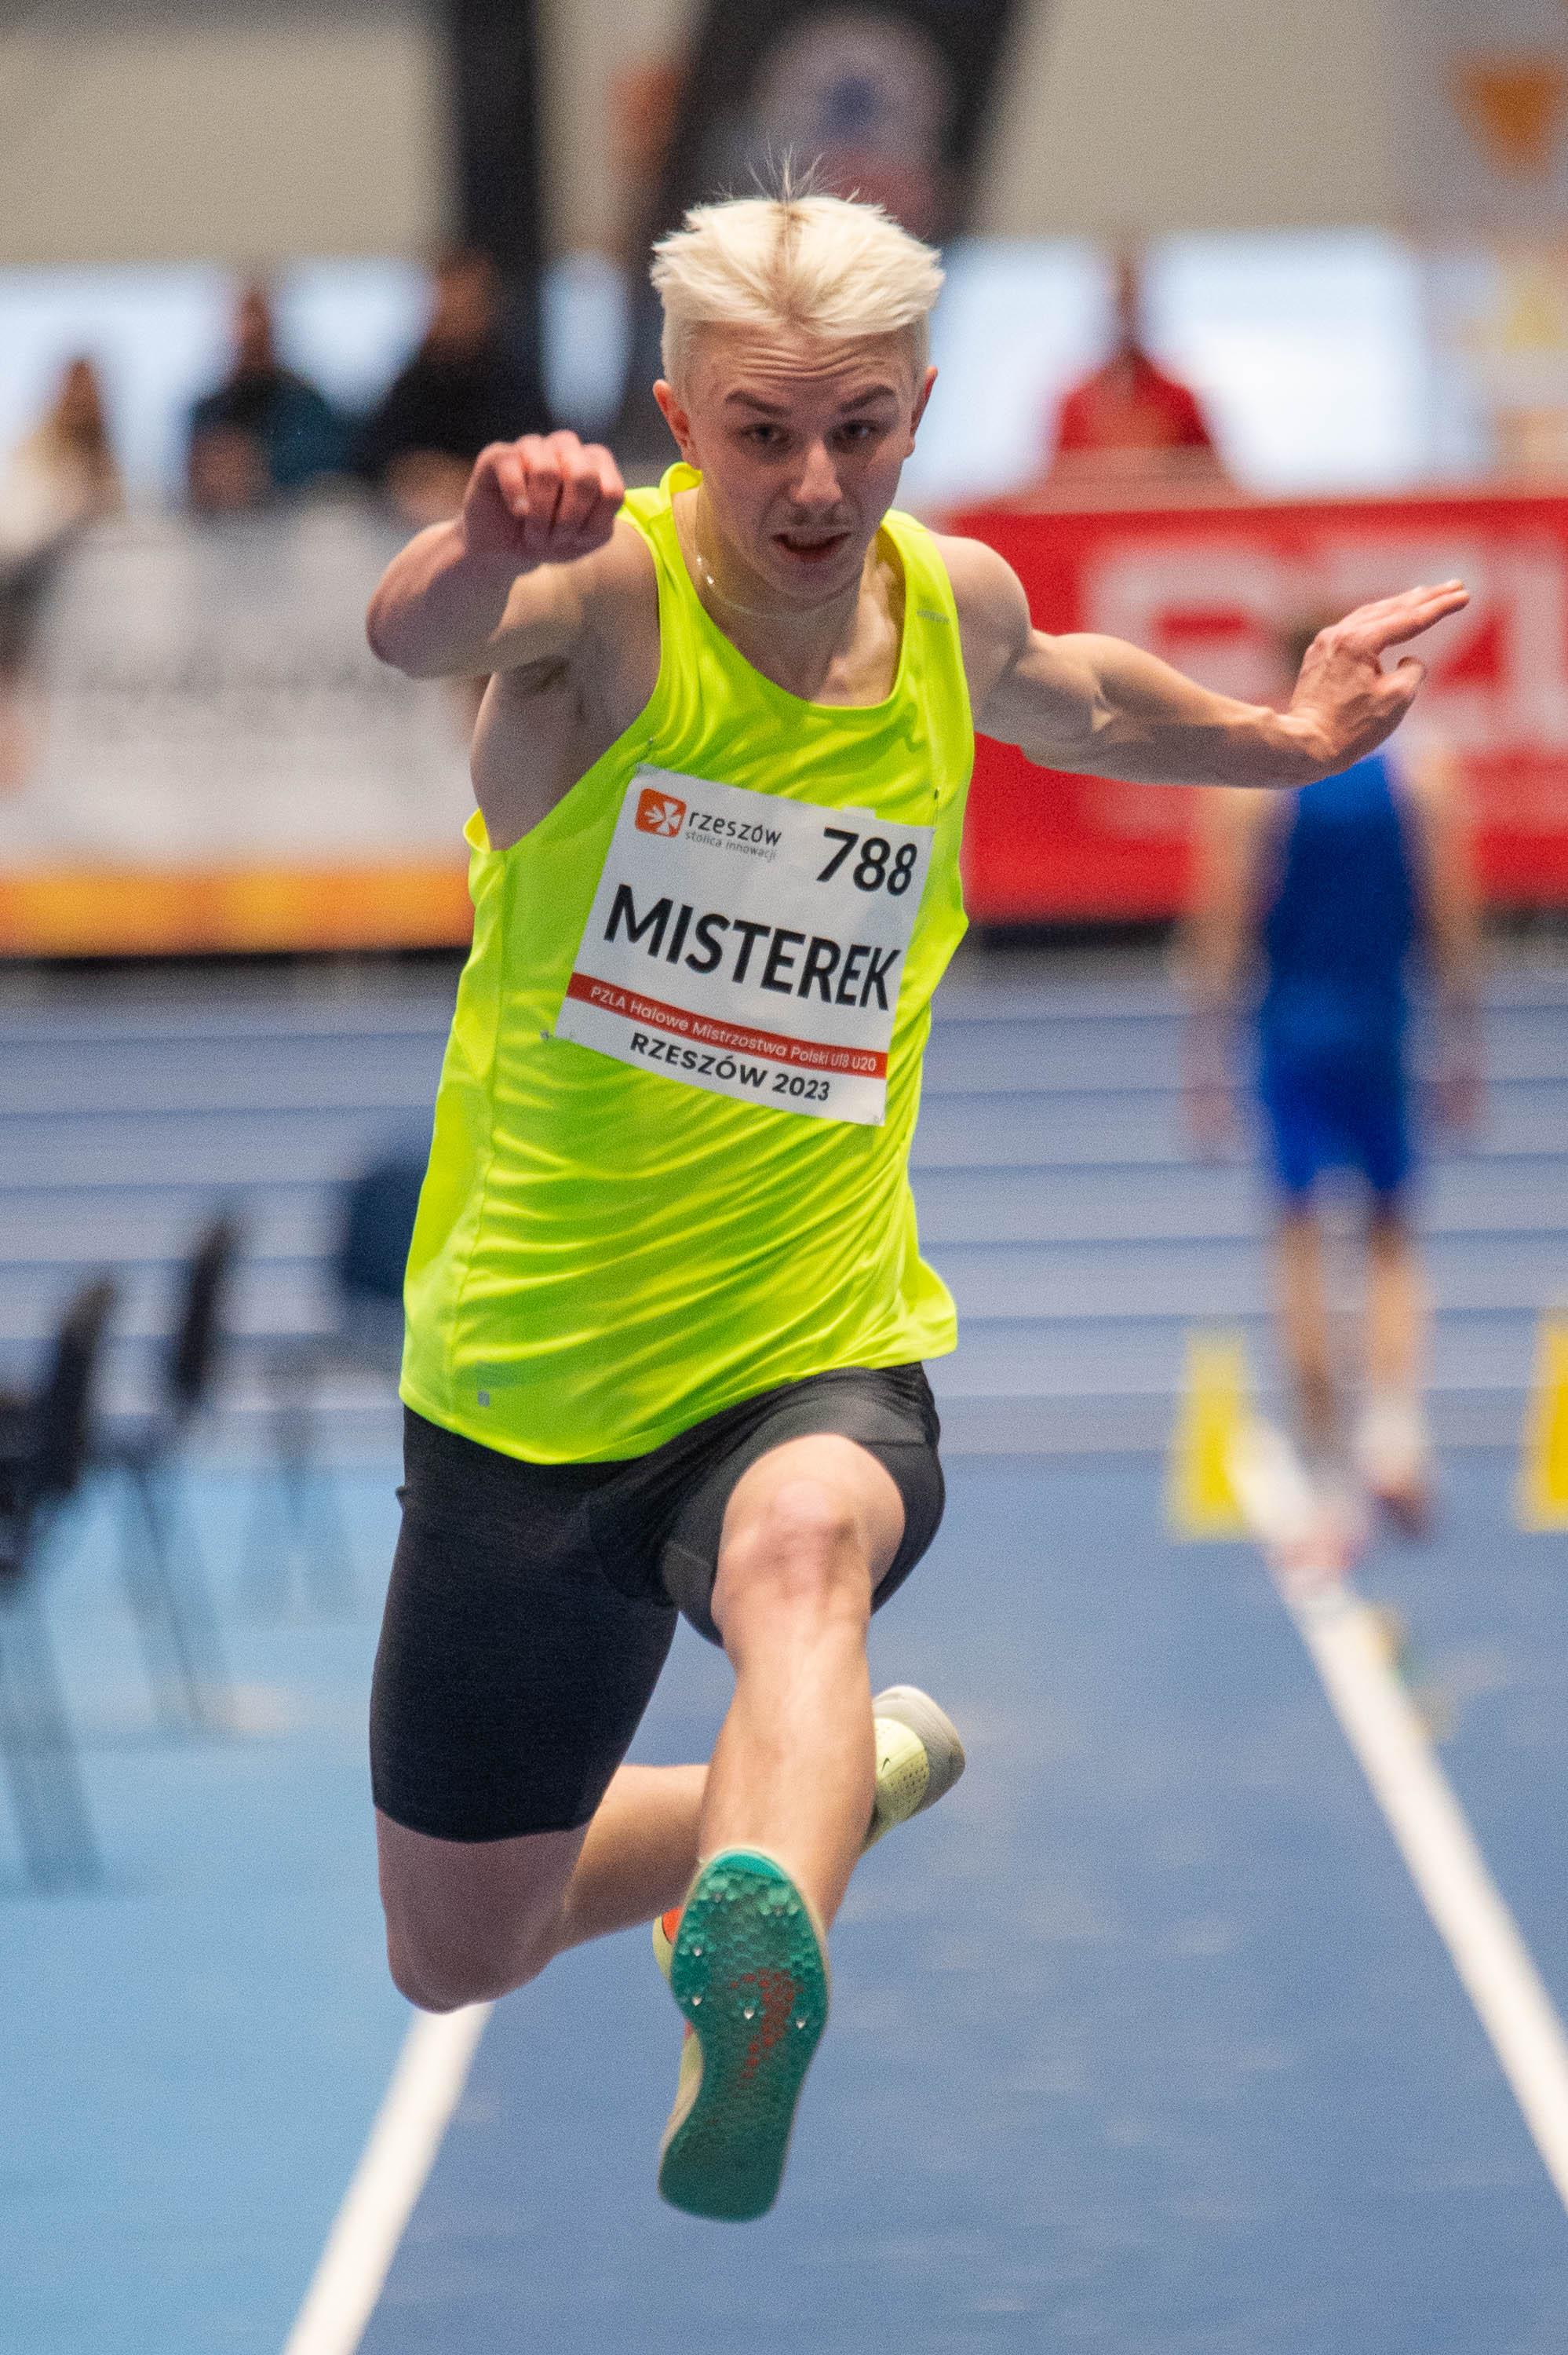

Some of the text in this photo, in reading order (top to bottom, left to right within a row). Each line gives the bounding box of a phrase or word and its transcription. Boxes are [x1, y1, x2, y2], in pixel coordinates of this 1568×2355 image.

[685, 831, 778, 864] stolica innowacji
[689, 812, 782, 847] rzeszów
[816, 827, 917, 896] 788
[603, 883, 902, 1011] MISTEREK
[590, 986, 877, 1072] PZLA Halowe Mistrzostwa Polski U18 U20
[630, 1032, 830, 1101] RZESZÓW 2023
